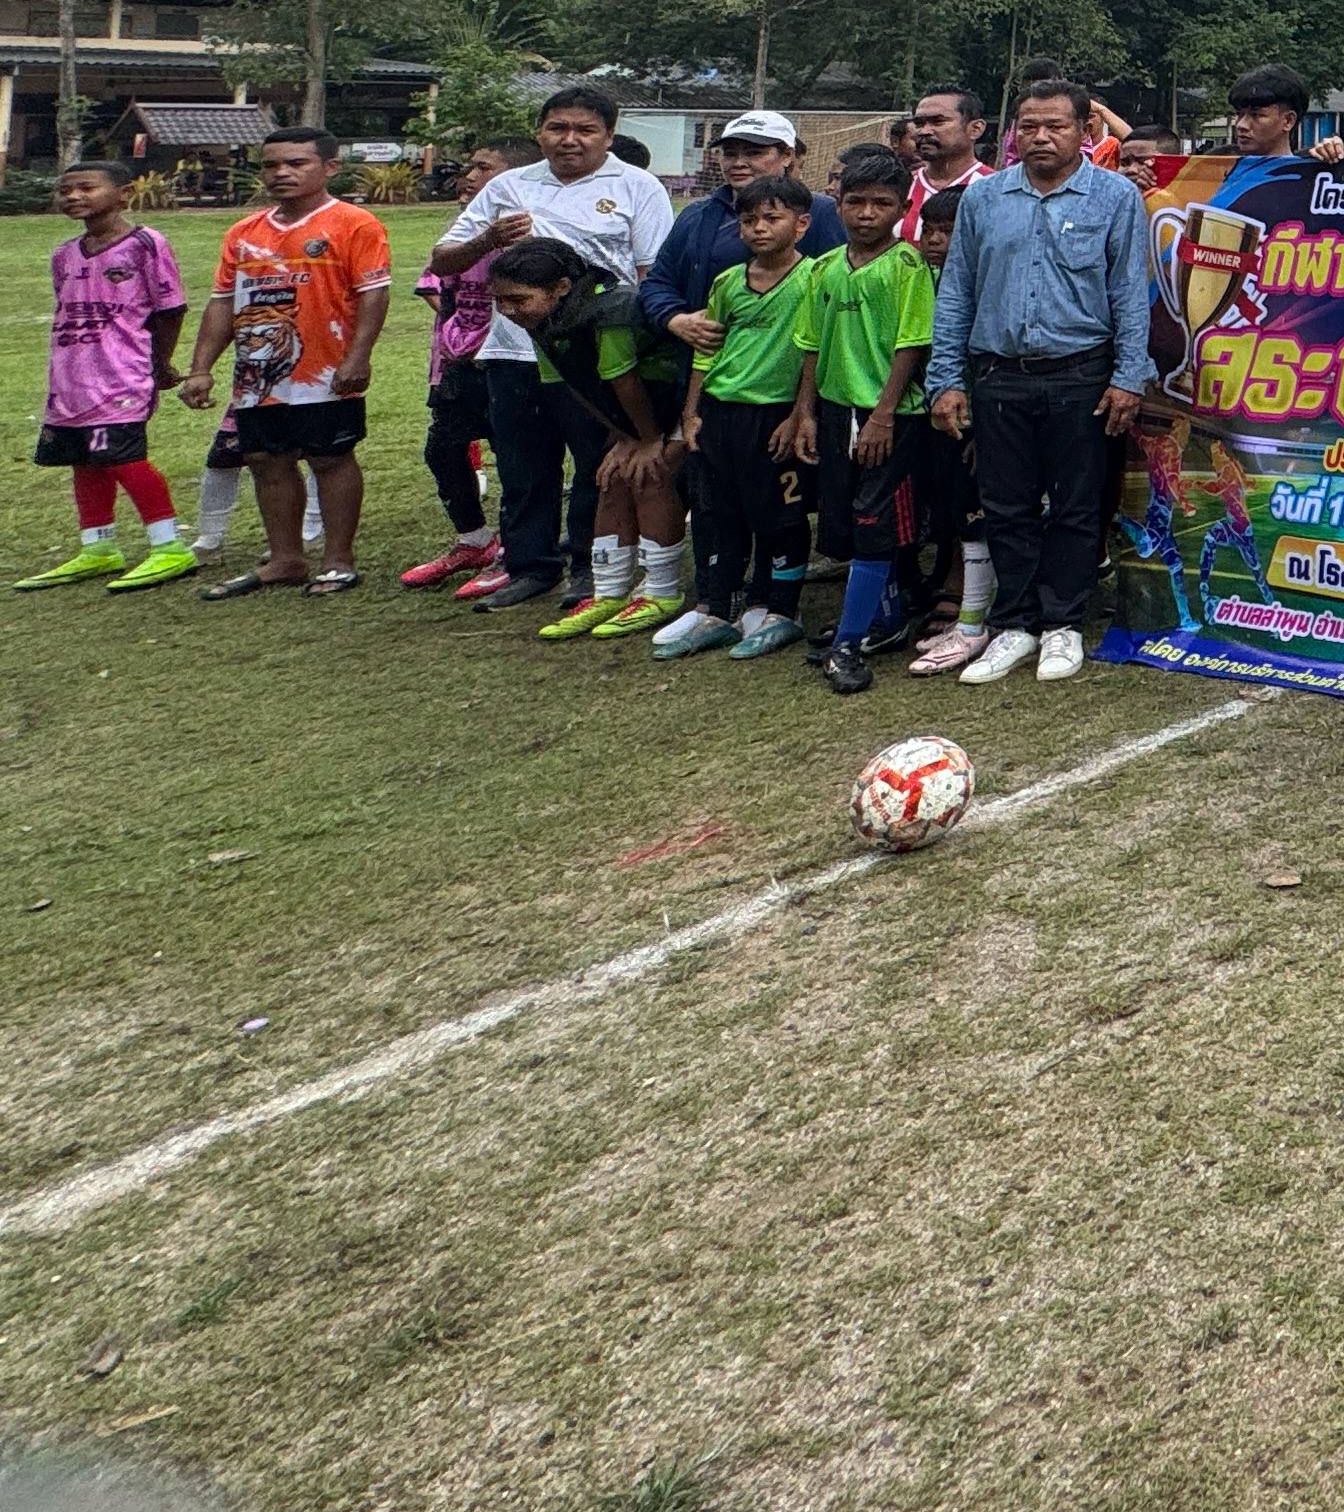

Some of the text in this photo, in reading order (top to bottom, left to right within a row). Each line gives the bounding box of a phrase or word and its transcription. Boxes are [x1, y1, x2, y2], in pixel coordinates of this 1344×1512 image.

[1193, 247, 1241, 269] WINNER
[779, 470, 803, 505] 2
[1270, 478, 1328, 524] วันที่
[1287, 554, 1311, 581] ณ
[1214, 597, 1312, 638] ตำบลลำพูน
